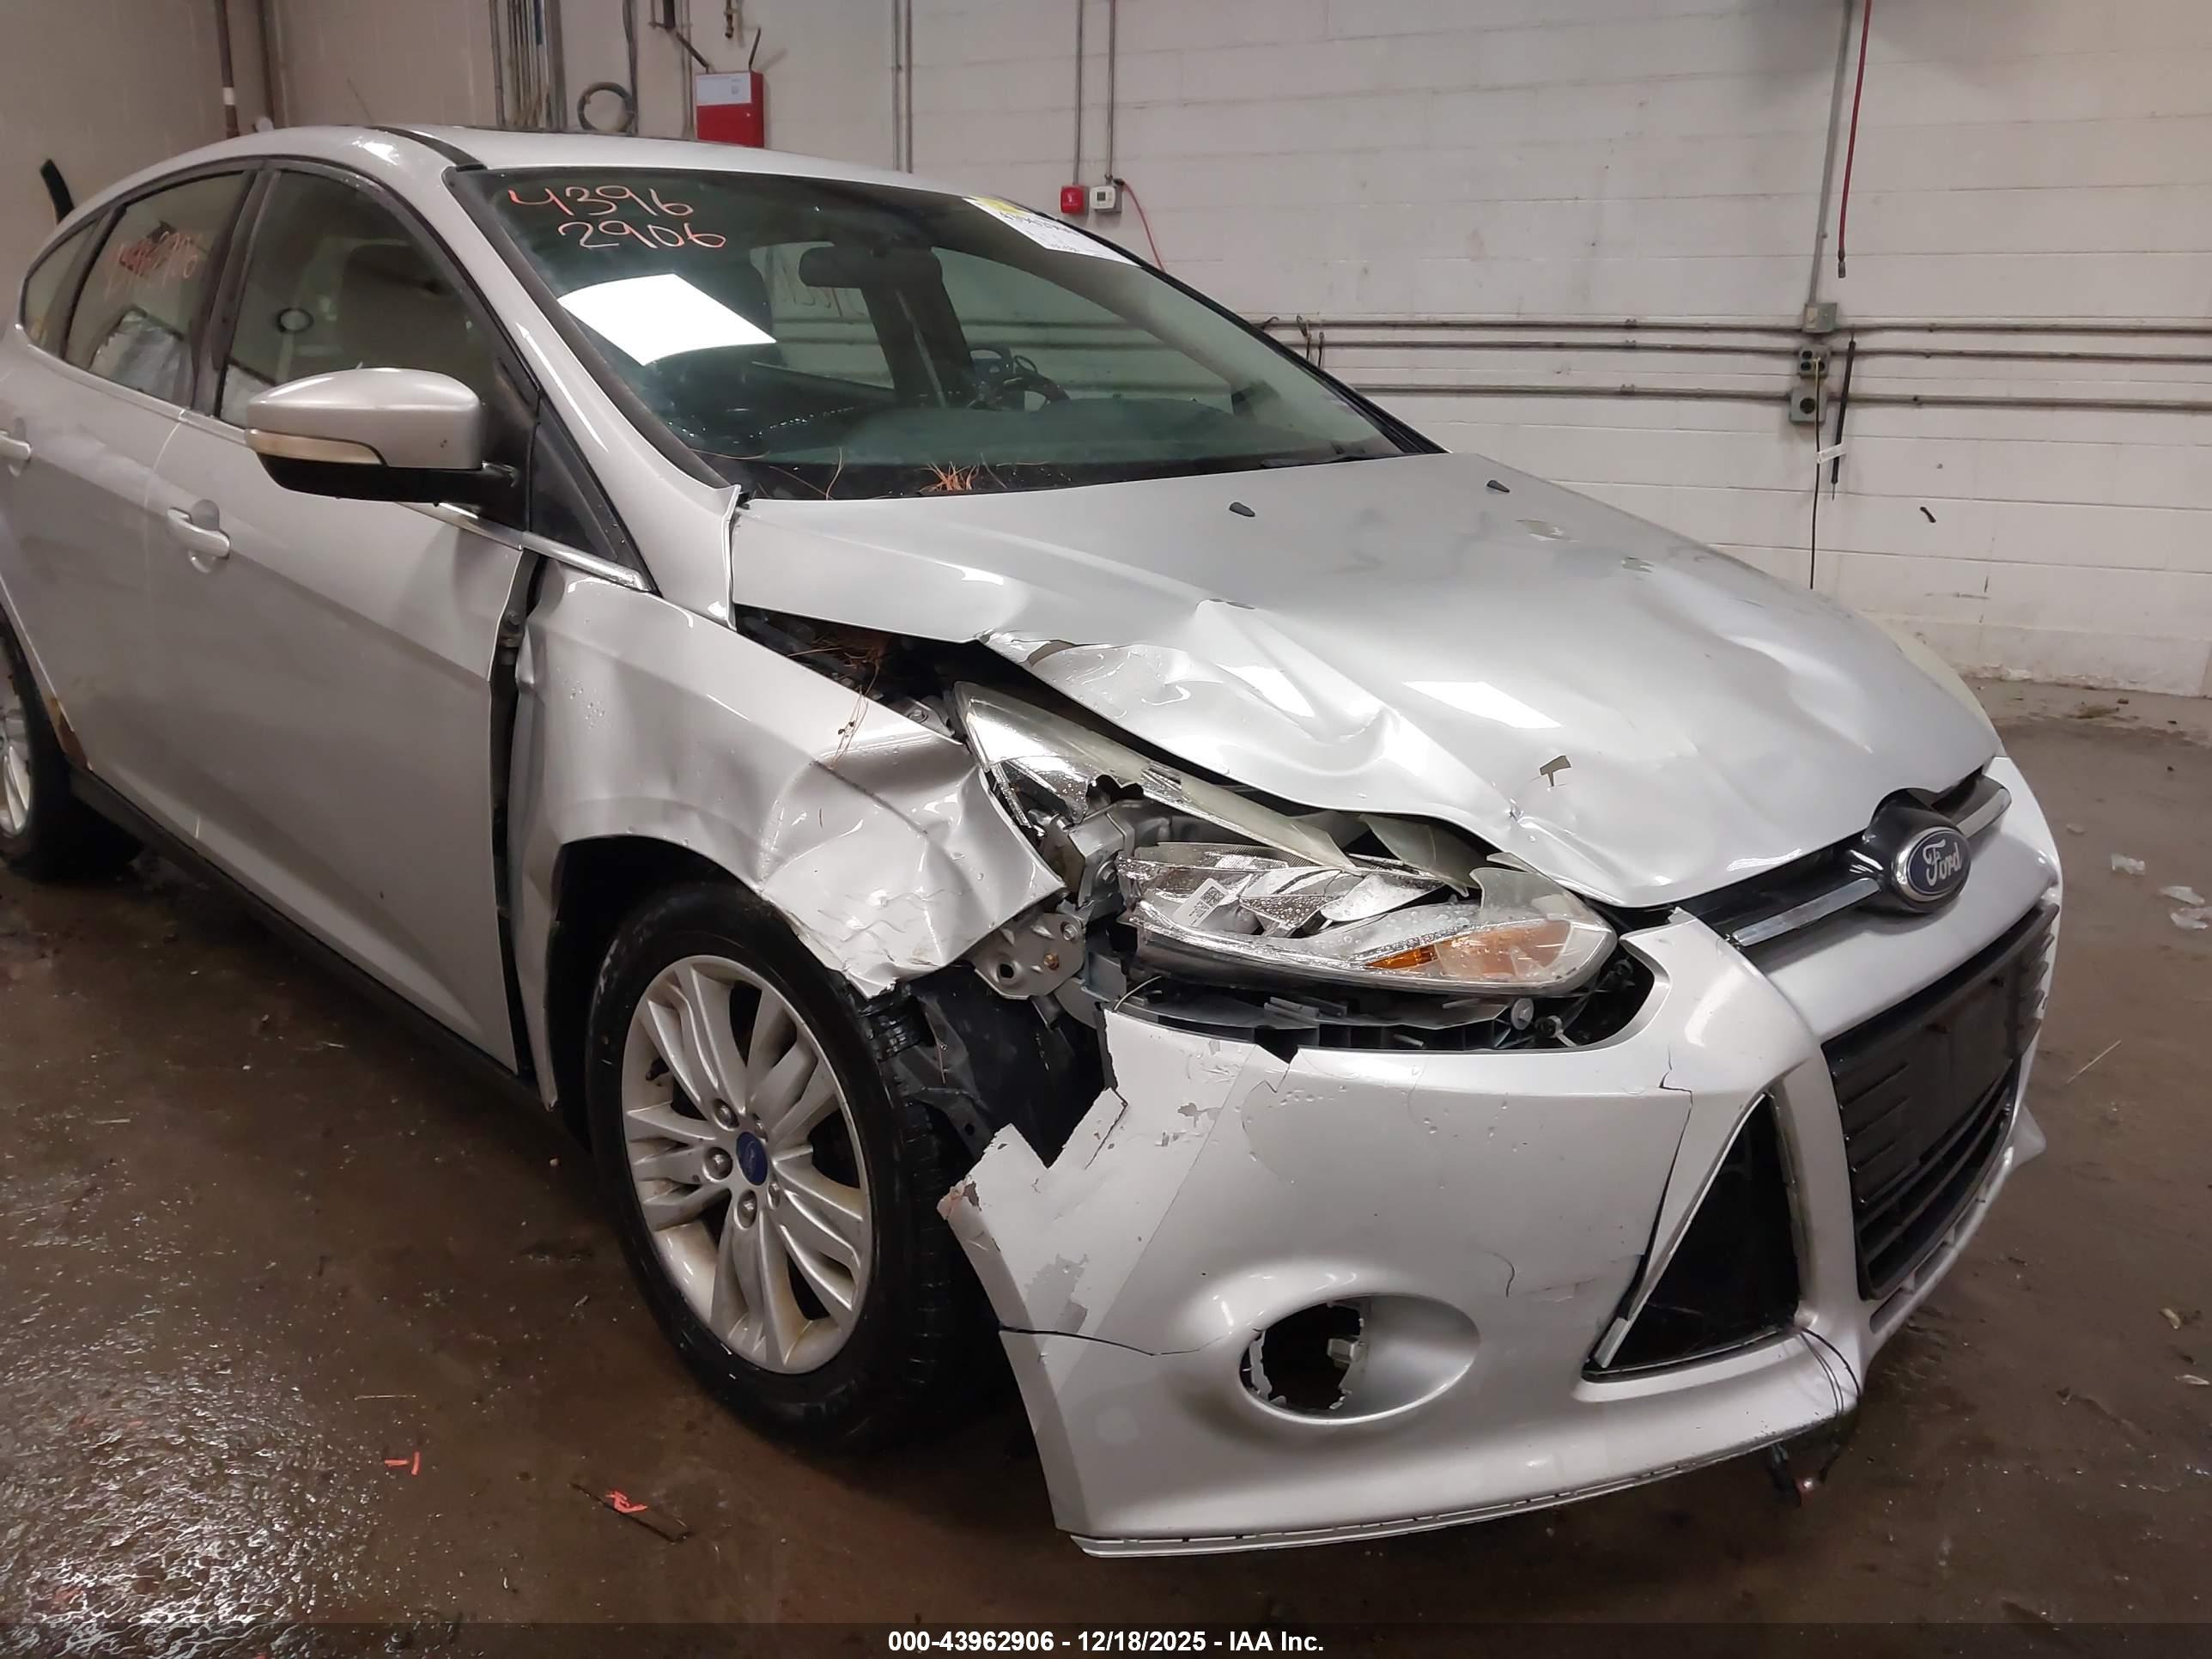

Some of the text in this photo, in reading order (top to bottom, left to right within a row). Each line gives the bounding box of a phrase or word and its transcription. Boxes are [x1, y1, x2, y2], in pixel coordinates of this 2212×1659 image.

[507, 185, 694, 216] 4396
[557, 220, 726, 249] 2906
[1923, 839, 1963, 886] Ford
